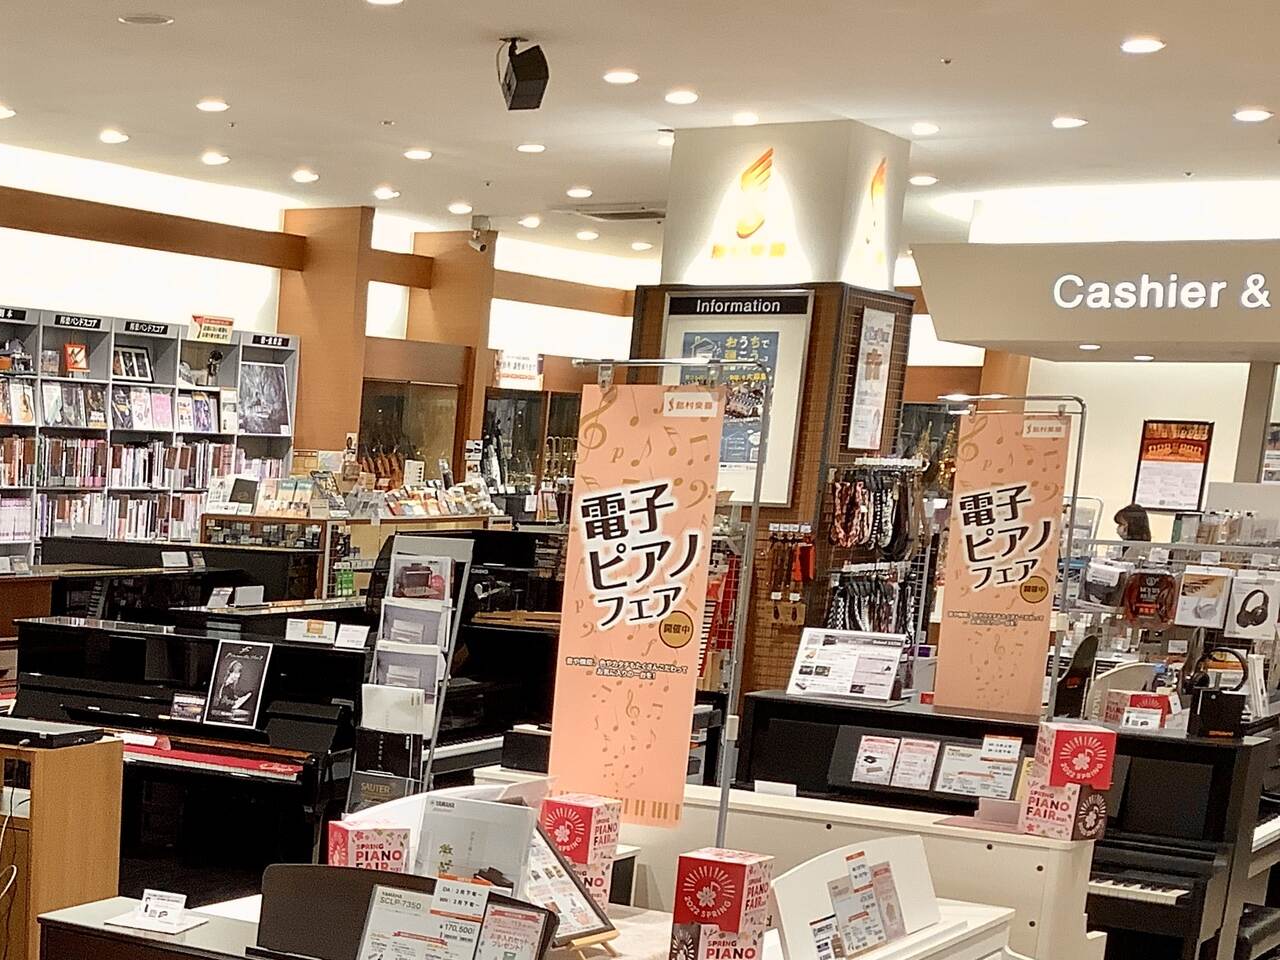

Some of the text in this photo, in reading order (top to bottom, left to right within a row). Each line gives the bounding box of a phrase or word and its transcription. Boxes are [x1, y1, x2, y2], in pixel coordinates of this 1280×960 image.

[1053, 274, 1271, 309] Cashier &
[696, 299, 780, 314] Information
[581, 483, 673, 541] 電子
[959, 485, 1031, 526] 電子
[966, 521, 1051, 563] ピアノ
[588, 533, 699, 591] ピアノ
[972, 558, 1039, 589] フェア
[597, 585, 682, 627] フェア
[361, 781, 391, 793] SAUTER
[1028, 797, 1069, 811] PIANO
[1026, 806, 1056, 820] FAIR
[595, 823, 618, 835] PIANO
[594, 836, 611, 848] FAIR
[356, 850, 402, 861] PIANO
[747, 882, 769, 898] PIANO
[684, 896, 732, 918] 2022 SPRING
[745, 896, 762, 911] FAIR
[706, 948, 756, 960] PIANO
